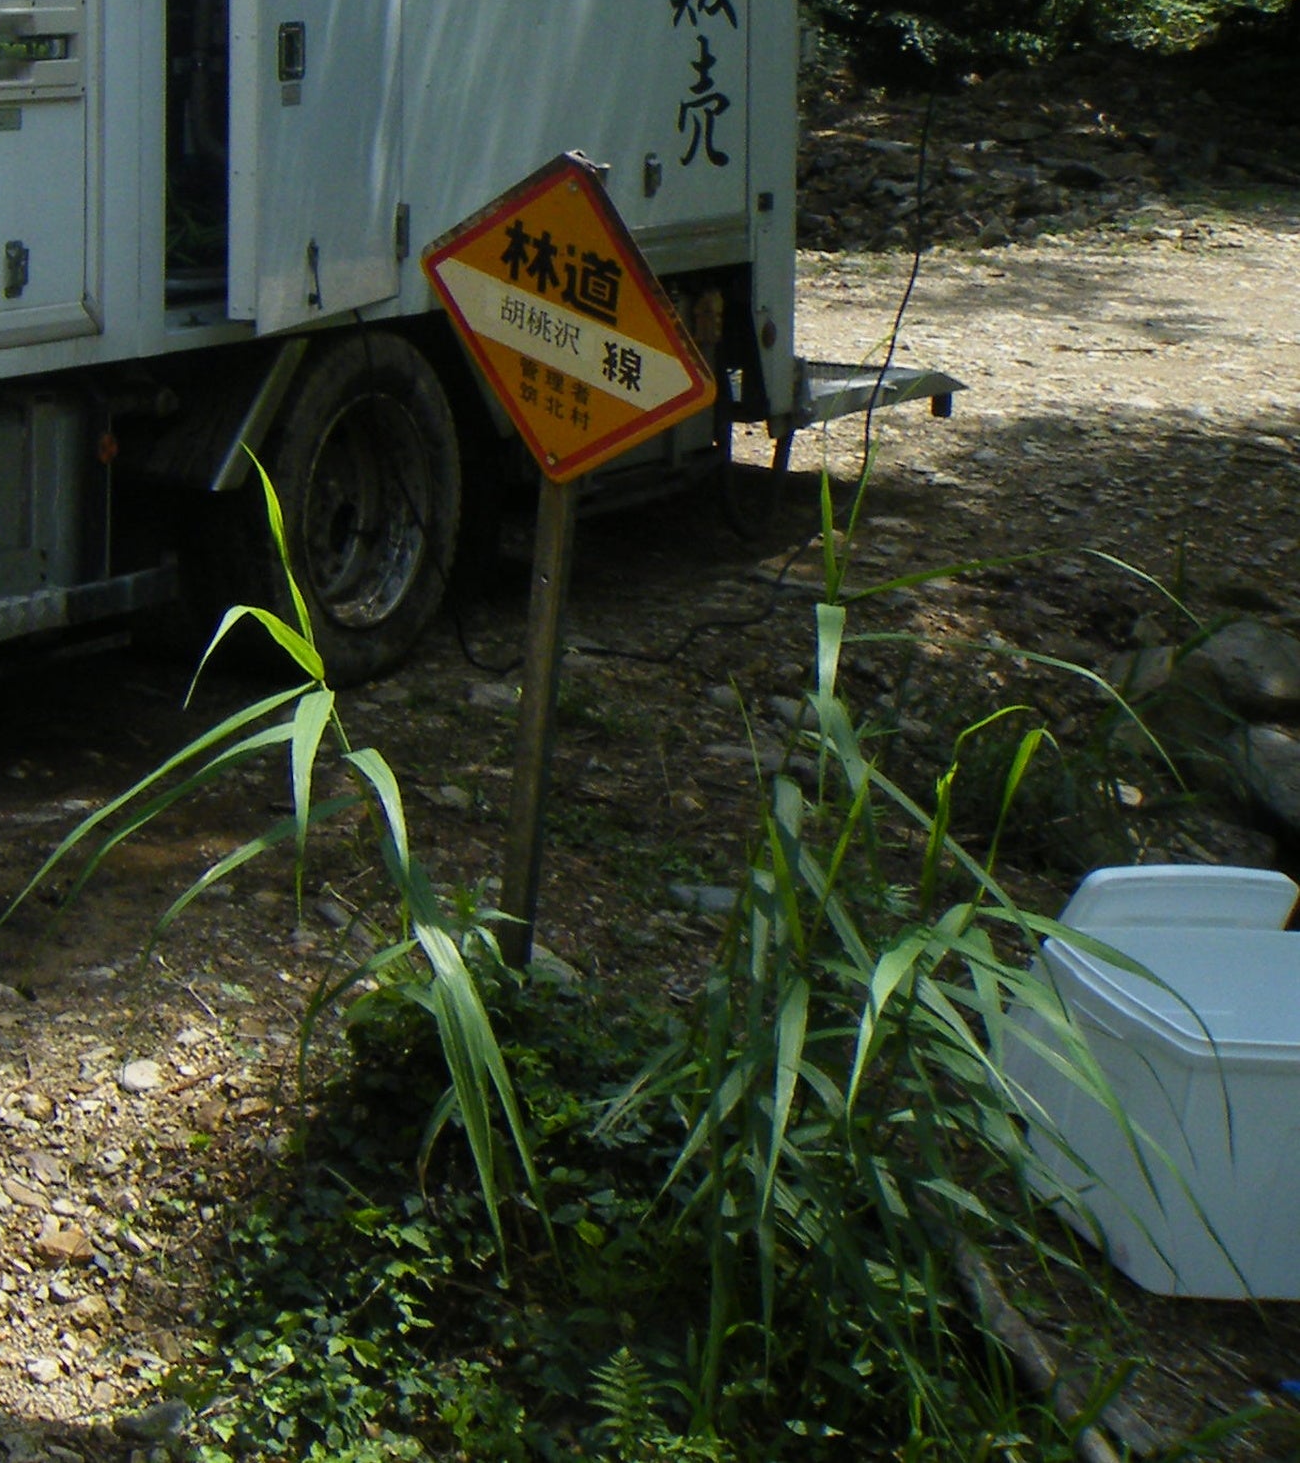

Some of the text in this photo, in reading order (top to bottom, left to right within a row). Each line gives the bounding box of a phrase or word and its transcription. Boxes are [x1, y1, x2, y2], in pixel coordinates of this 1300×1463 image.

[500, 218, 622, 326] 林道
[500, 295, 642, 392] 胡桃沢 線
